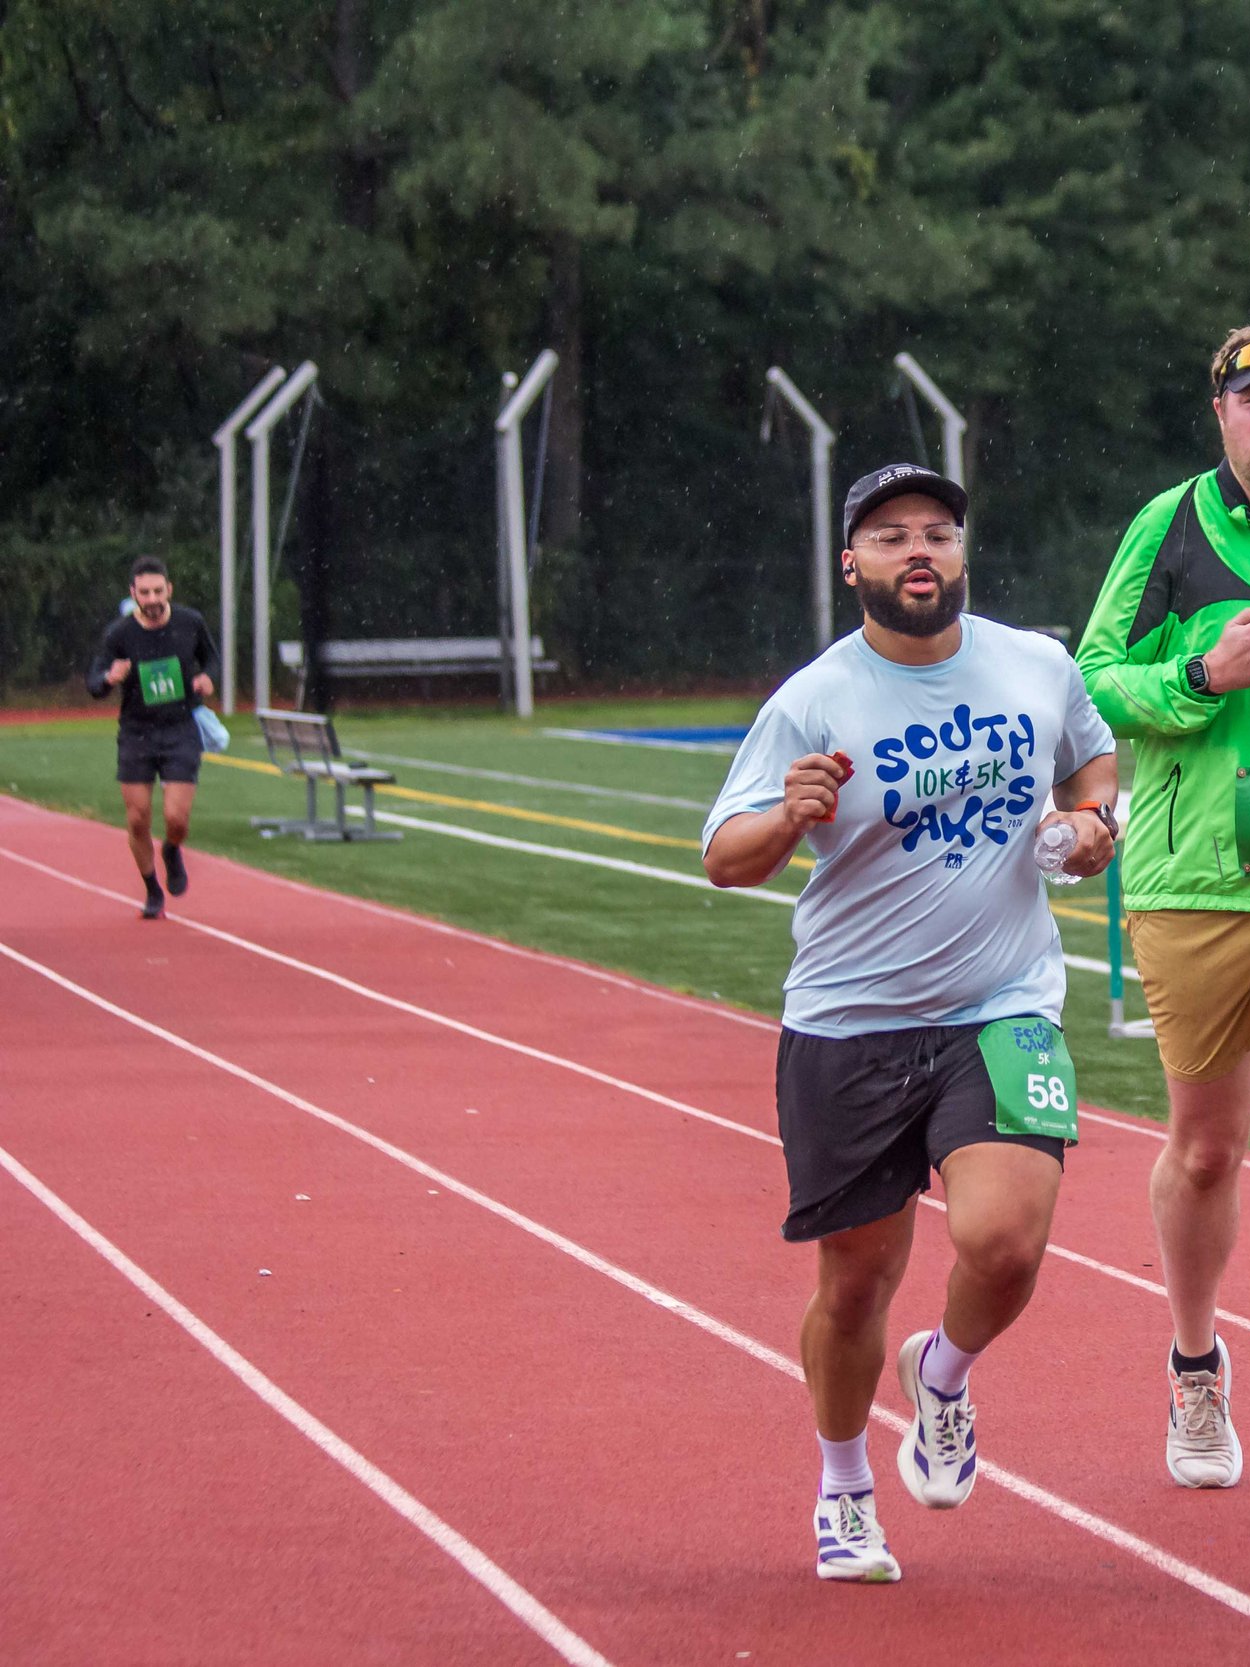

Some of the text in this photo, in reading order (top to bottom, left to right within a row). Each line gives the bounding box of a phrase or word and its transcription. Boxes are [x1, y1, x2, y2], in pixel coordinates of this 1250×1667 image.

[873, 704, 1035, 783] SOUTH
[915, 759, 1006, 799] 10K & 5K
[883, 775, 1035, 852] LAKES
[1037, 1052, 1051, 1066] 5K
[1027, 1073, 1069, 1112] 58
